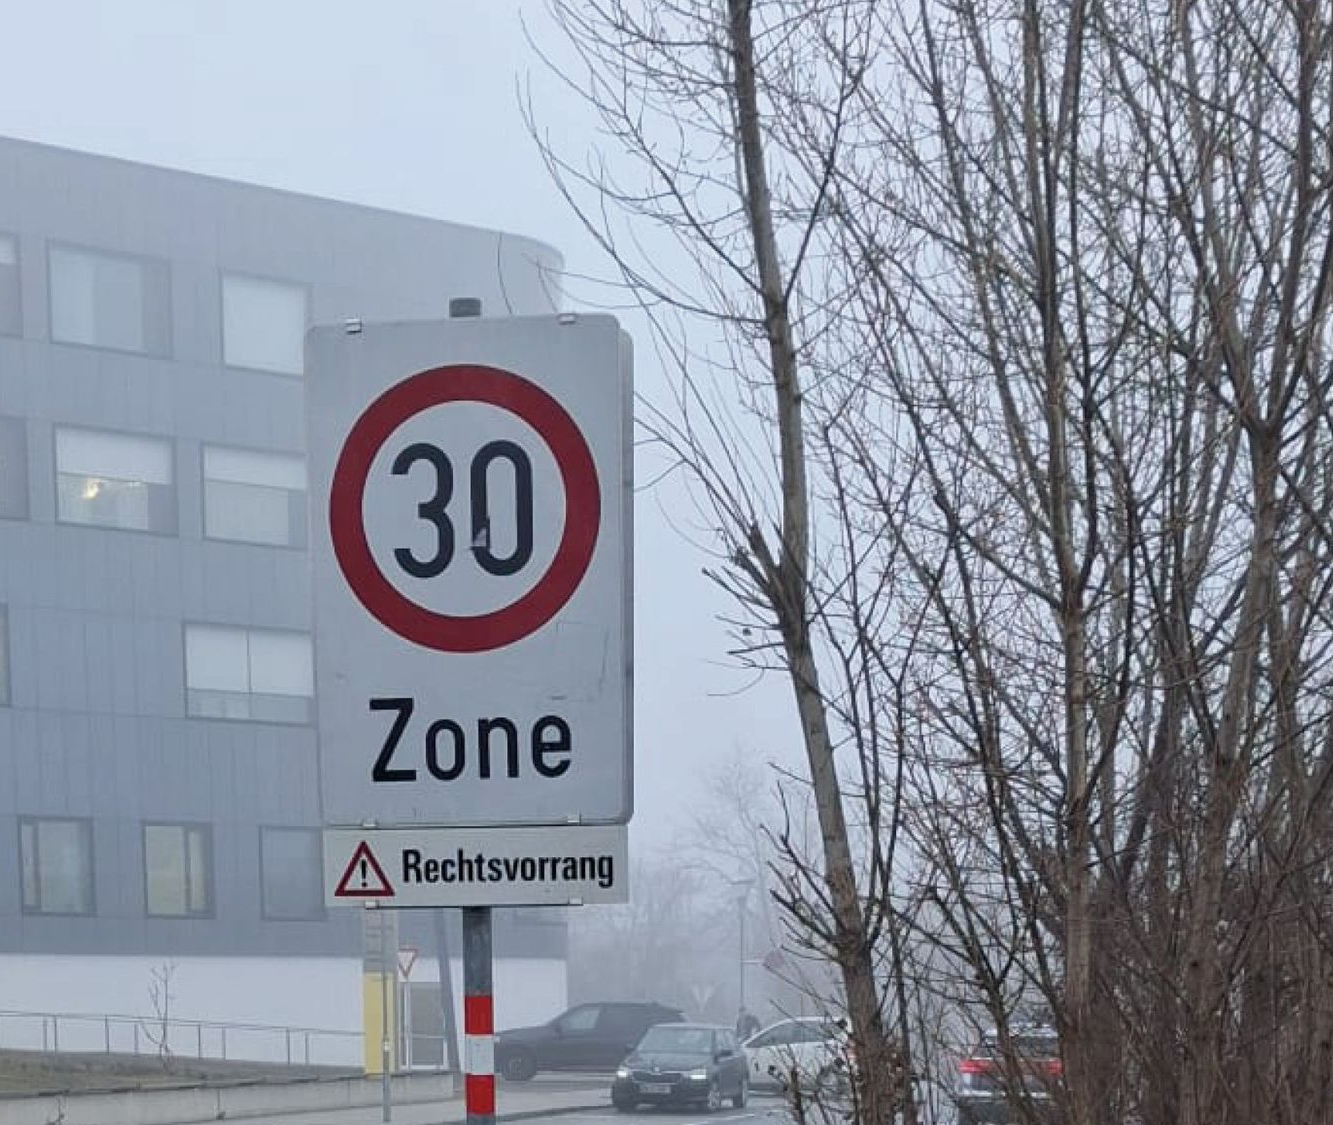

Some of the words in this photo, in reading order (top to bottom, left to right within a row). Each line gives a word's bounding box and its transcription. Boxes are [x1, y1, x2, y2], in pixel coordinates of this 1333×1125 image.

[391, 439, 534, 579] 30
[368, 697, 572, 783] Zone
[402, 848, 614, 889] Rechtsvorrang
